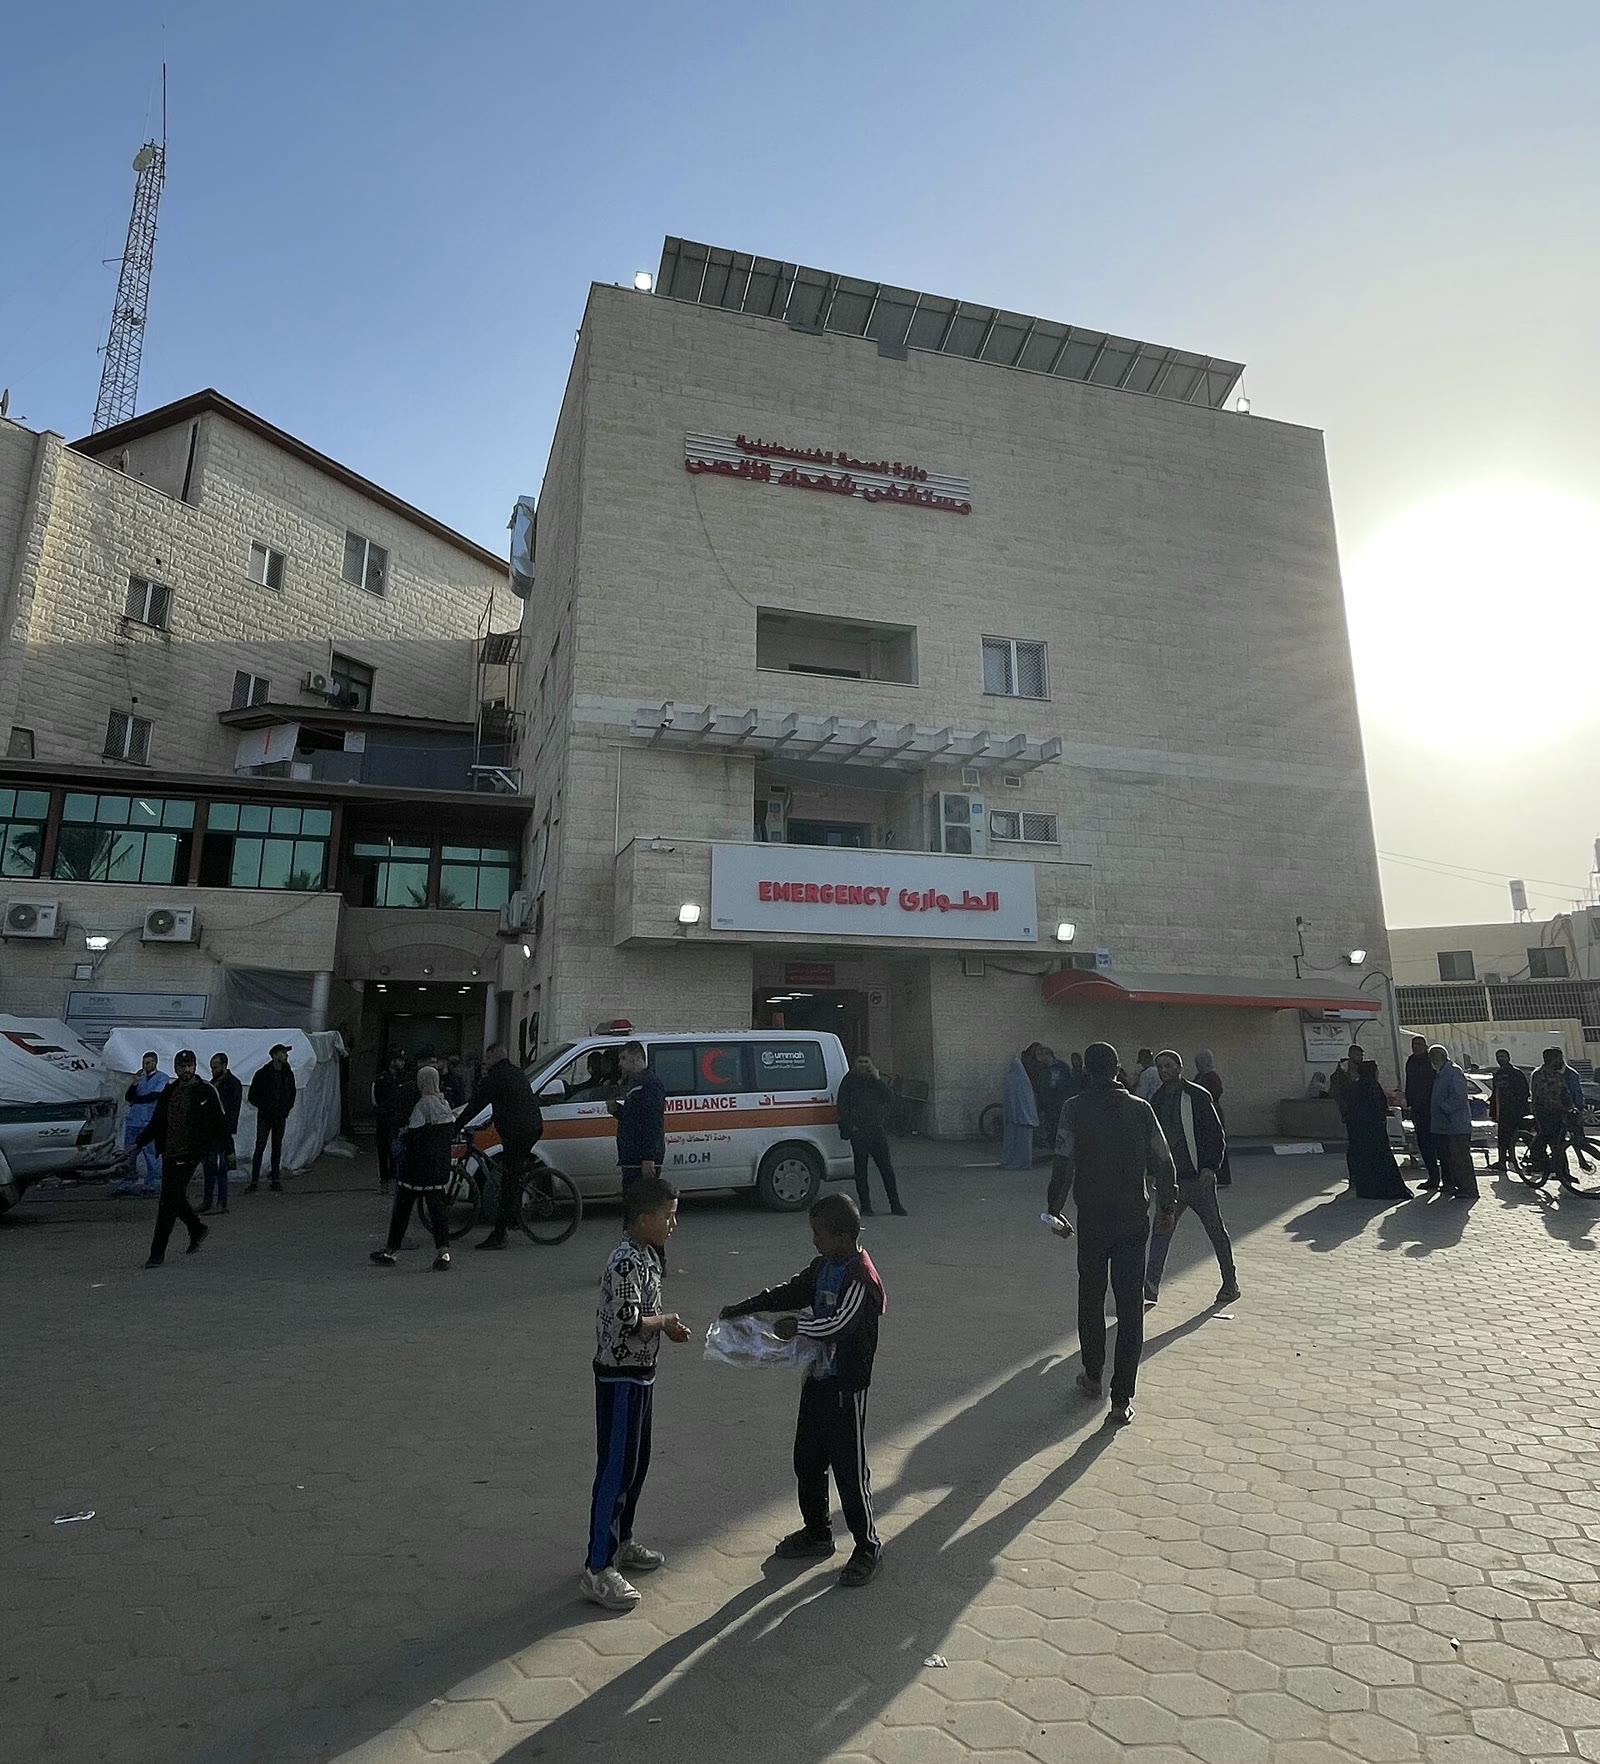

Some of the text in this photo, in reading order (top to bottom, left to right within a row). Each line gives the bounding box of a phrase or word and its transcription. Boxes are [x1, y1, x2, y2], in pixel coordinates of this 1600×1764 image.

[838, 451, 890, 474] الصحة
[758, 881, 890, 906] EMERGENCY
[774, 1051, 805, 1059] ummah
[663, 1096, 737, 1112] MBULANCE
[673, 1152, 711, 1165] M.O.H
